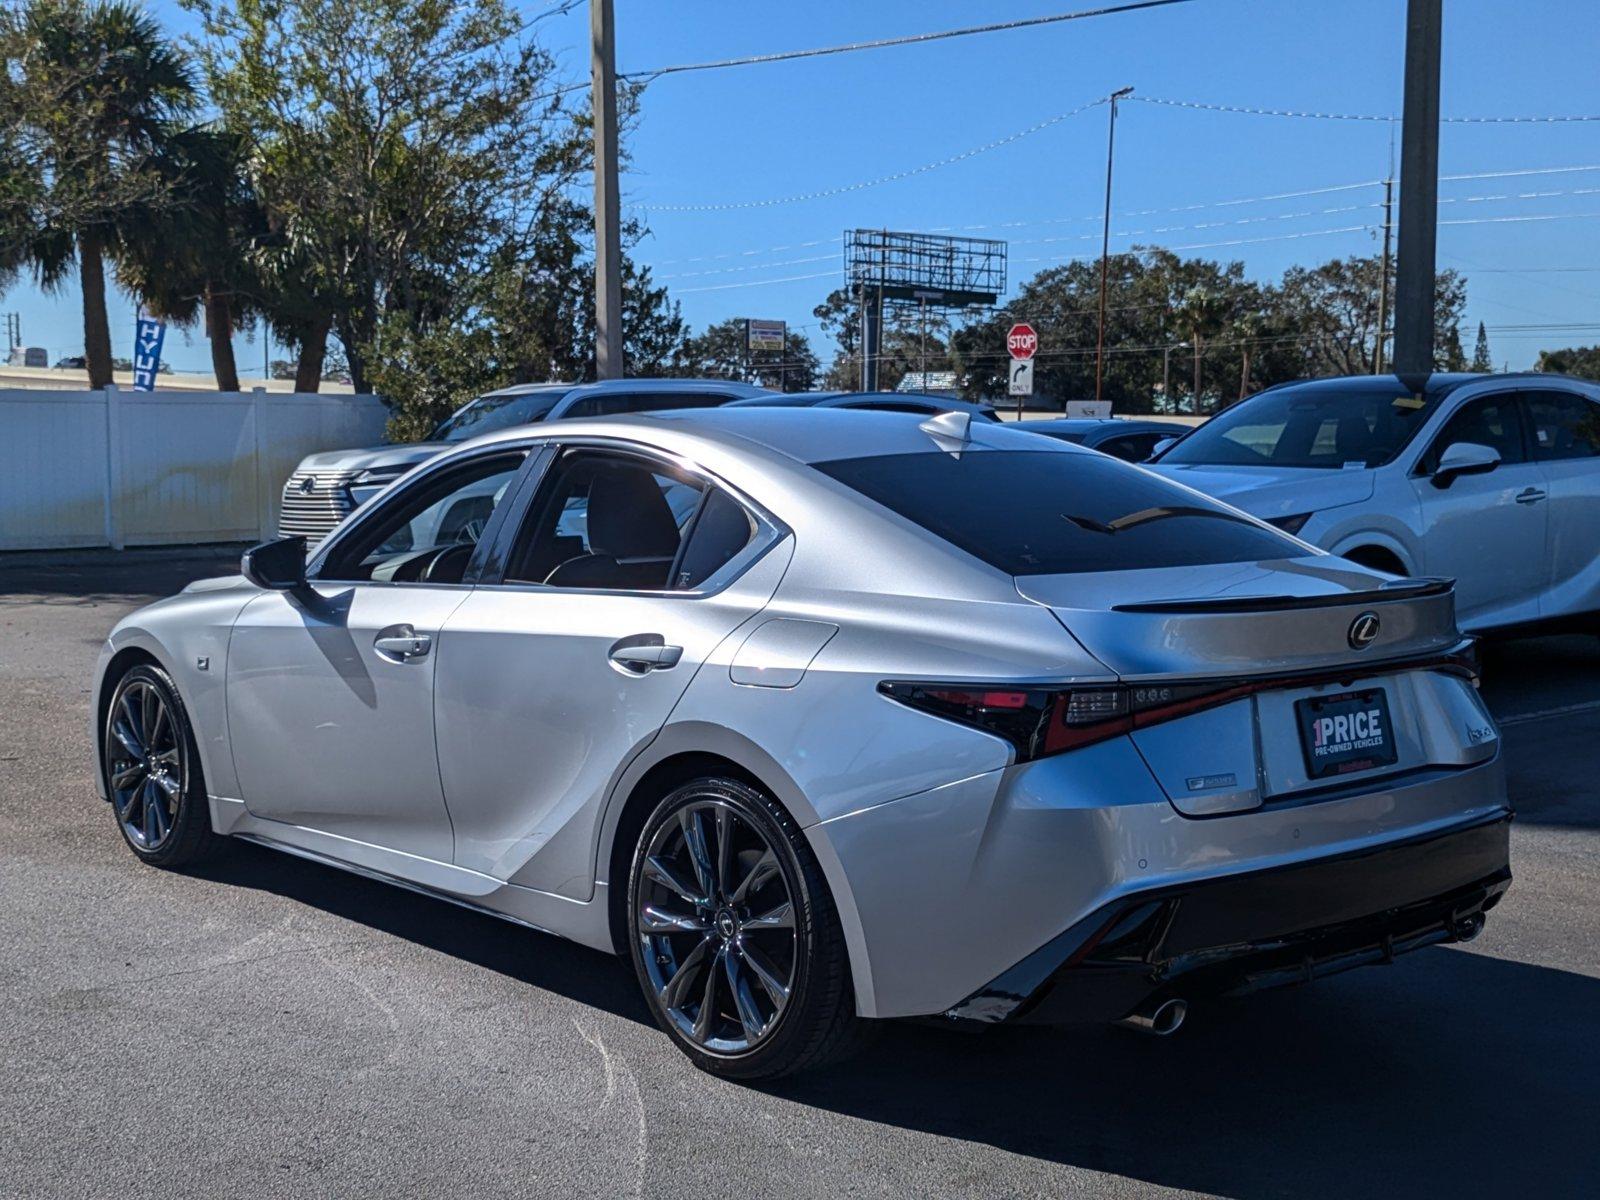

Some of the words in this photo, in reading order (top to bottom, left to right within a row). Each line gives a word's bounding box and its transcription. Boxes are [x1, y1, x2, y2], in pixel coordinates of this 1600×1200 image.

[1009, 335, 1035, 348] STOP
[134, 323, 160, 391] HYUN
[1011, 384, 1029, 392] ONLY
[1313, 709, 1382, 746] 1PRICE
[1315, 741, 1352, 756] PRE-OWNED
[1353, 736, 1383, 749] VEHICLES
